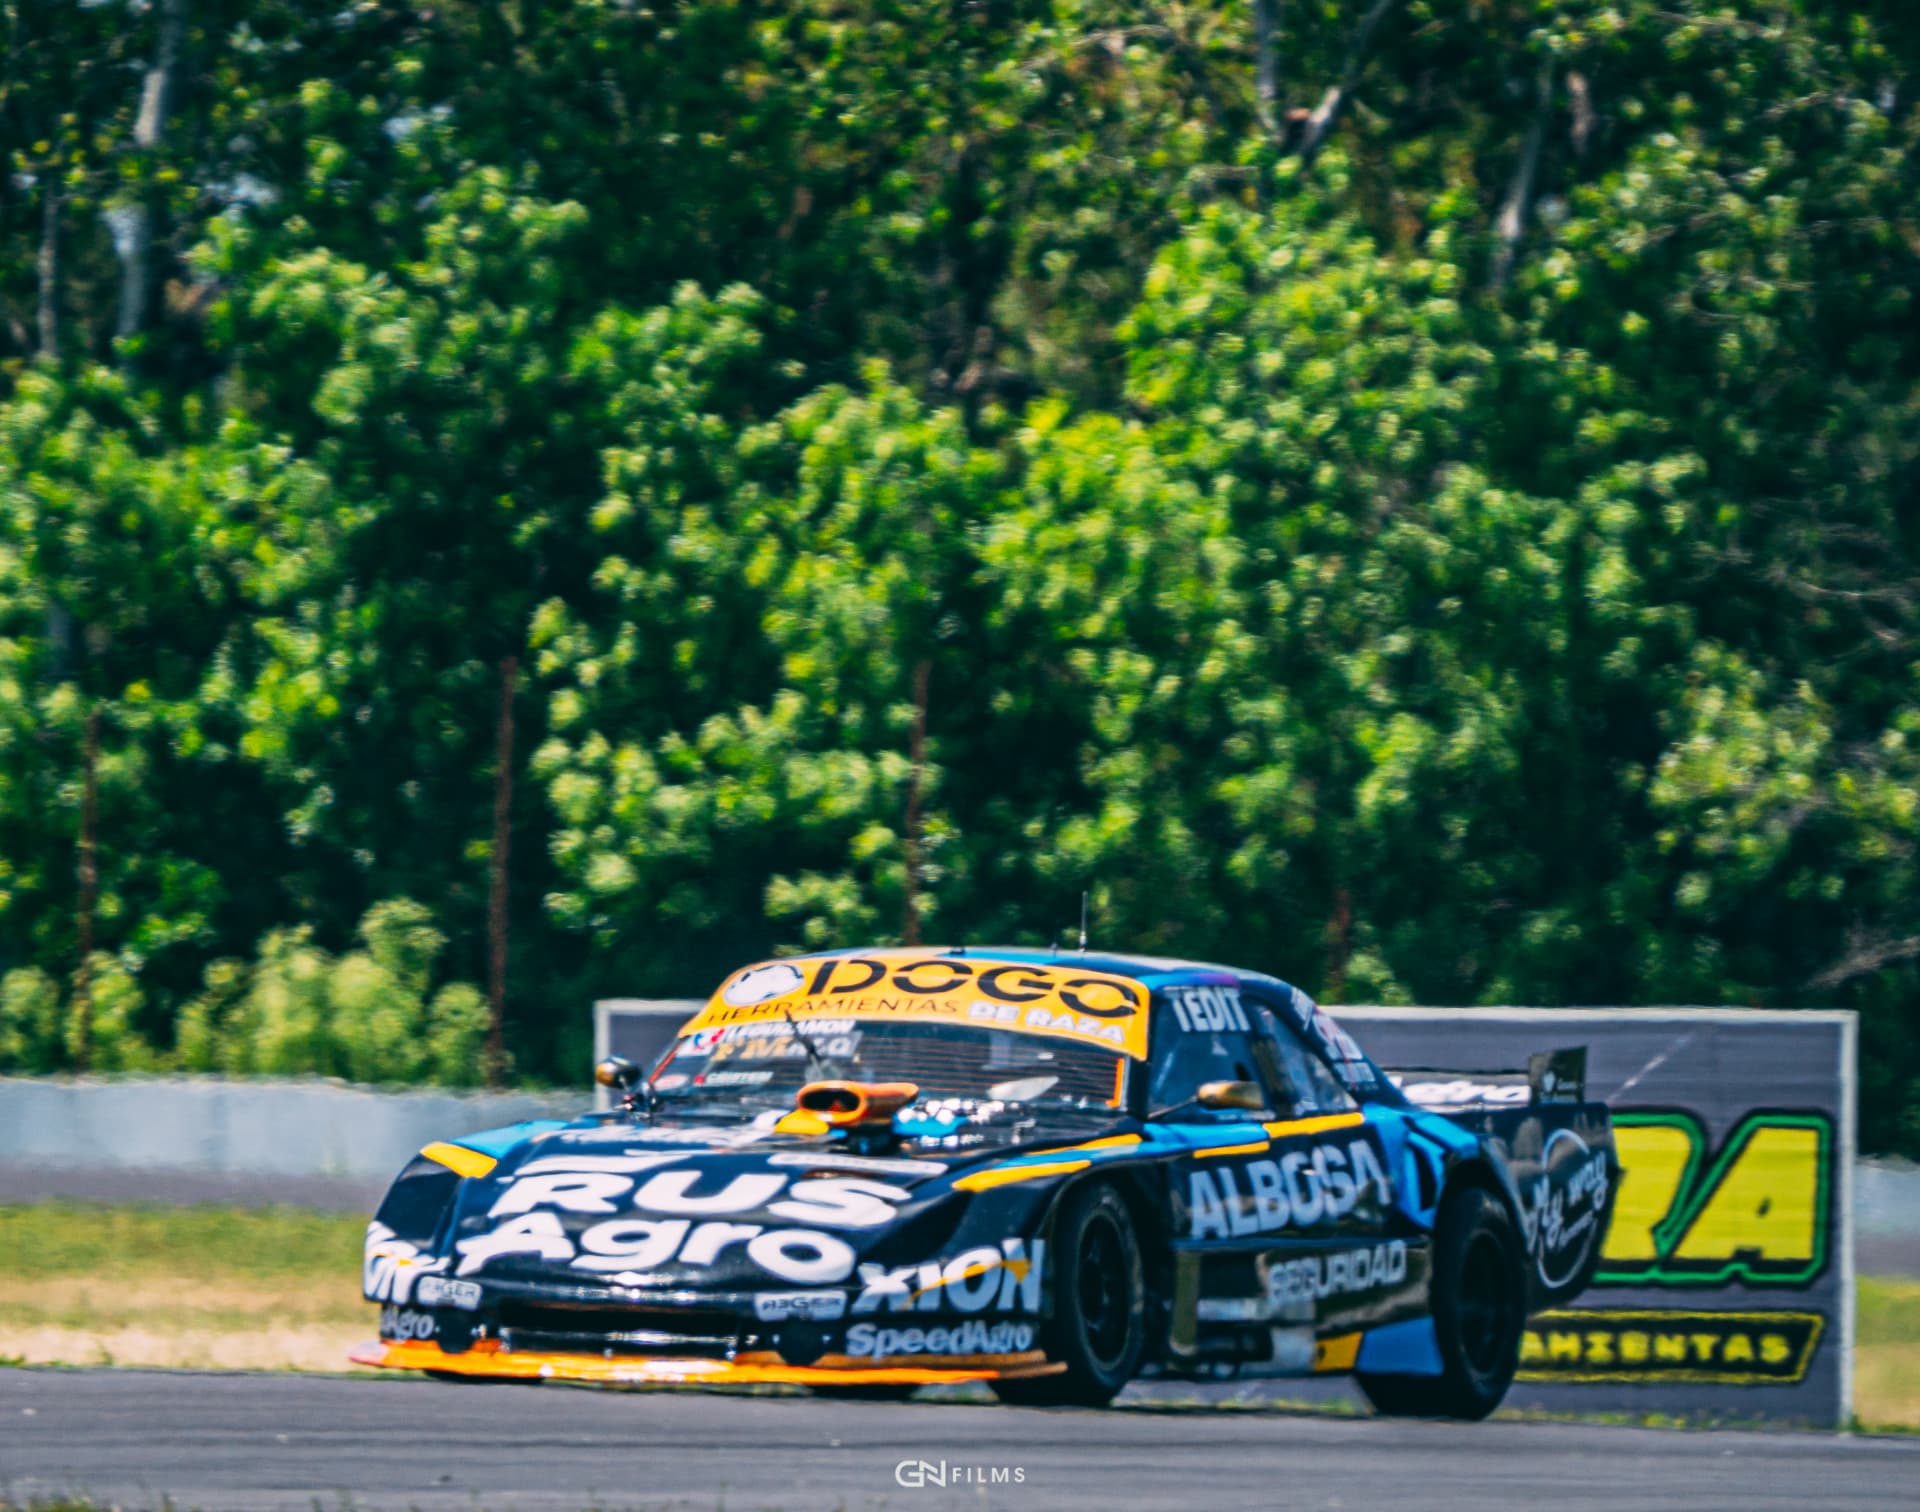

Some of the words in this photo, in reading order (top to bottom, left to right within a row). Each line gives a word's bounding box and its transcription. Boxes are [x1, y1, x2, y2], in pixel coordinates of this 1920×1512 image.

[806, 958, 1142, 1019] DOGO
[708, 997, 960, 1024] HERRAMIENTAS
[968, 1001, 1020, 1023] DE
[1025, 1007, 1126, 1043] RAZA
[488, 1170, 913, 1229] RUS
[1190, 1140, 1392, 1240] ALBOSA
[456, 1212, 857, 1284] Agro
[1267, 1239, 1408, 1304] SEGURIDAD
[846, 1319, 1034, 1362] SpeedAgro
